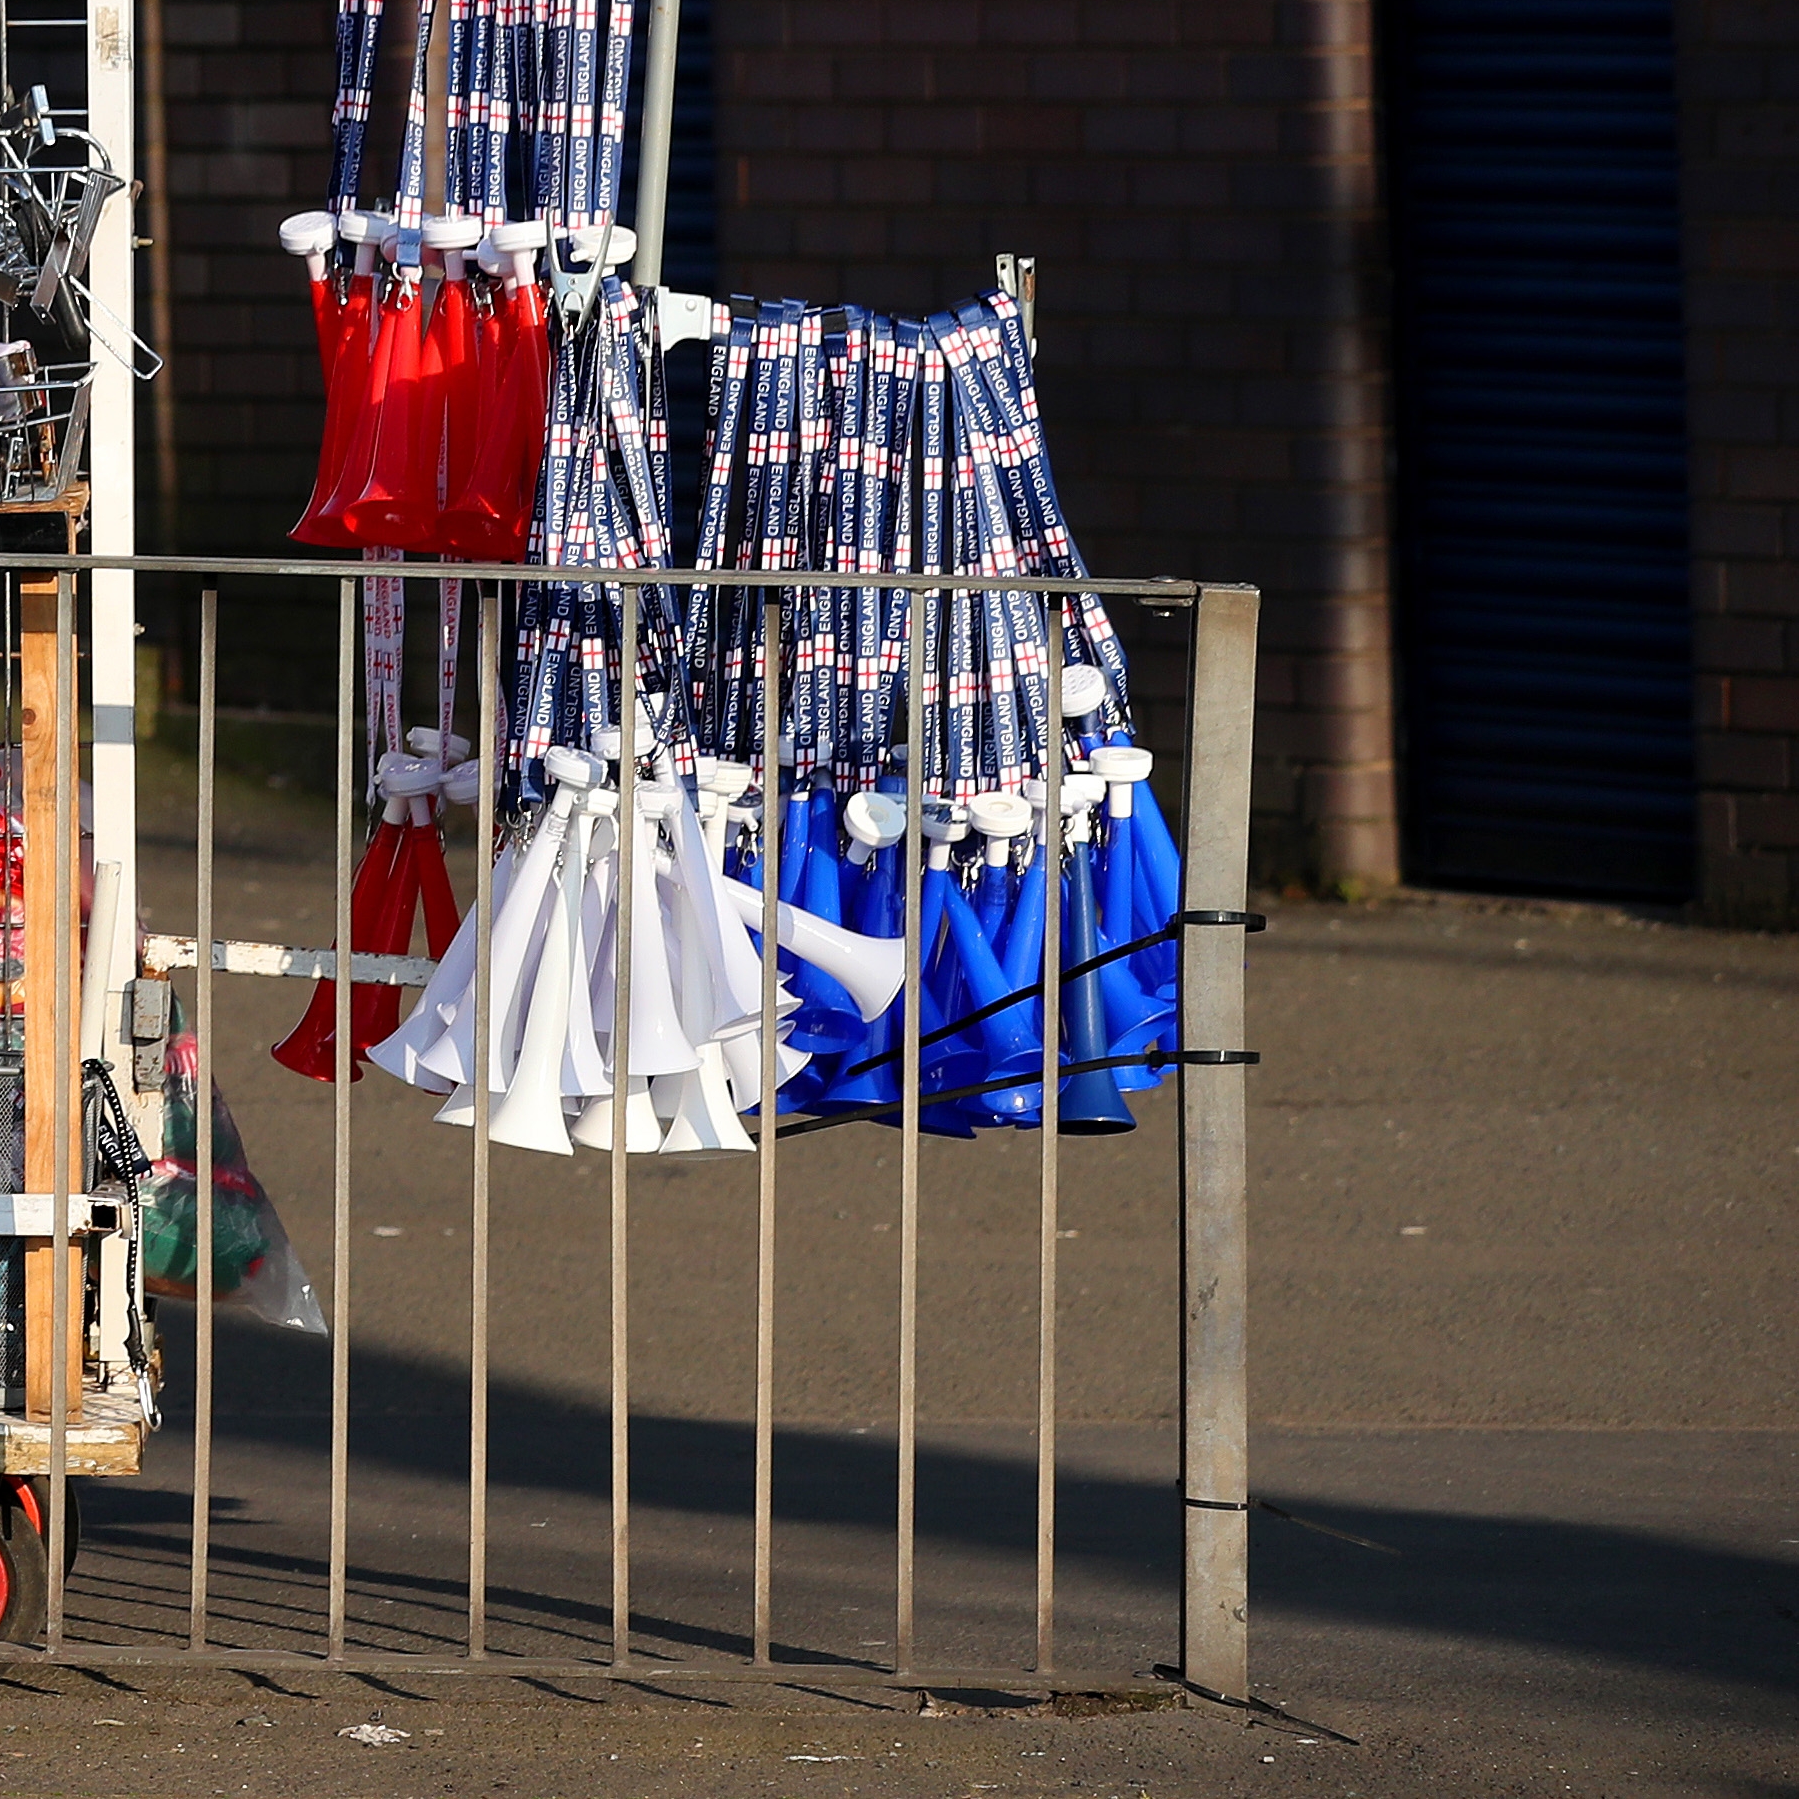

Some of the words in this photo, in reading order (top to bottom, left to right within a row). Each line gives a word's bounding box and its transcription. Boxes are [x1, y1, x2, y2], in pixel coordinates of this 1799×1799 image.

[452, 23, 465, 93] ENGLAND
[556, 29, 567, 100] ENGLAND
[578, 32, 591, 103] ENGLAND
[408, 127, 422, 196] ENGLAND
[489, 134, 500, 205] ENGLAND
[551, 136, 562, 207] ENGLAND
[573, 139, 588, 211] ENGLAND
[598, 137, 612, 208] ENGLAND
[708, 345, 726, 416] ENGLAND
[721, 381, 741, 451] ENGLAND
[755, 361, 772, 432] ENGLAND
[775, 358, 792, 429] ENGLAND
[804, 347, 816, 418] ENGLAND
[844, 364, 857, 436] ENGLAND
[986, 359, 1023, 427] ENGLAND
[928, 384, 939, 456] ENGLAND
[553, 459, 566, 531] ENGLAND
[592, 483, 611, 555] ENGLAND
[701, 486, 722, 557] ENGLAND
[768, 465, 783, 536] ENGLAND
[842, 472, 854, 543] ENGLAND
[864, 477, 874, 548] ENGLAND
[963, 490, 977, 560] ENGLAND
[980, 465, 1004, 534] ENGLAND
[1008, 470, 1033, 537] ENGLAND
[1028, 458, 1056, 525] ENGLAND
[927, 492, 938, 564] ENGLAND
[840, 587, 851, 652] NGLAND
[926, 599, 937, 671] ENGLAND
[537, 653, 560, 725] ENGLAND
[799, 674, 811, 745] ENGLAND
[818, 668, 830, 744] ENGLAND
[838, 688, 849, 759] ENGLAND
[862, 692, 874, 764] ENGLAND
[959, 706, 973, 777] ENGLAND
[997, 694, 1015, 766] ENGLAND
